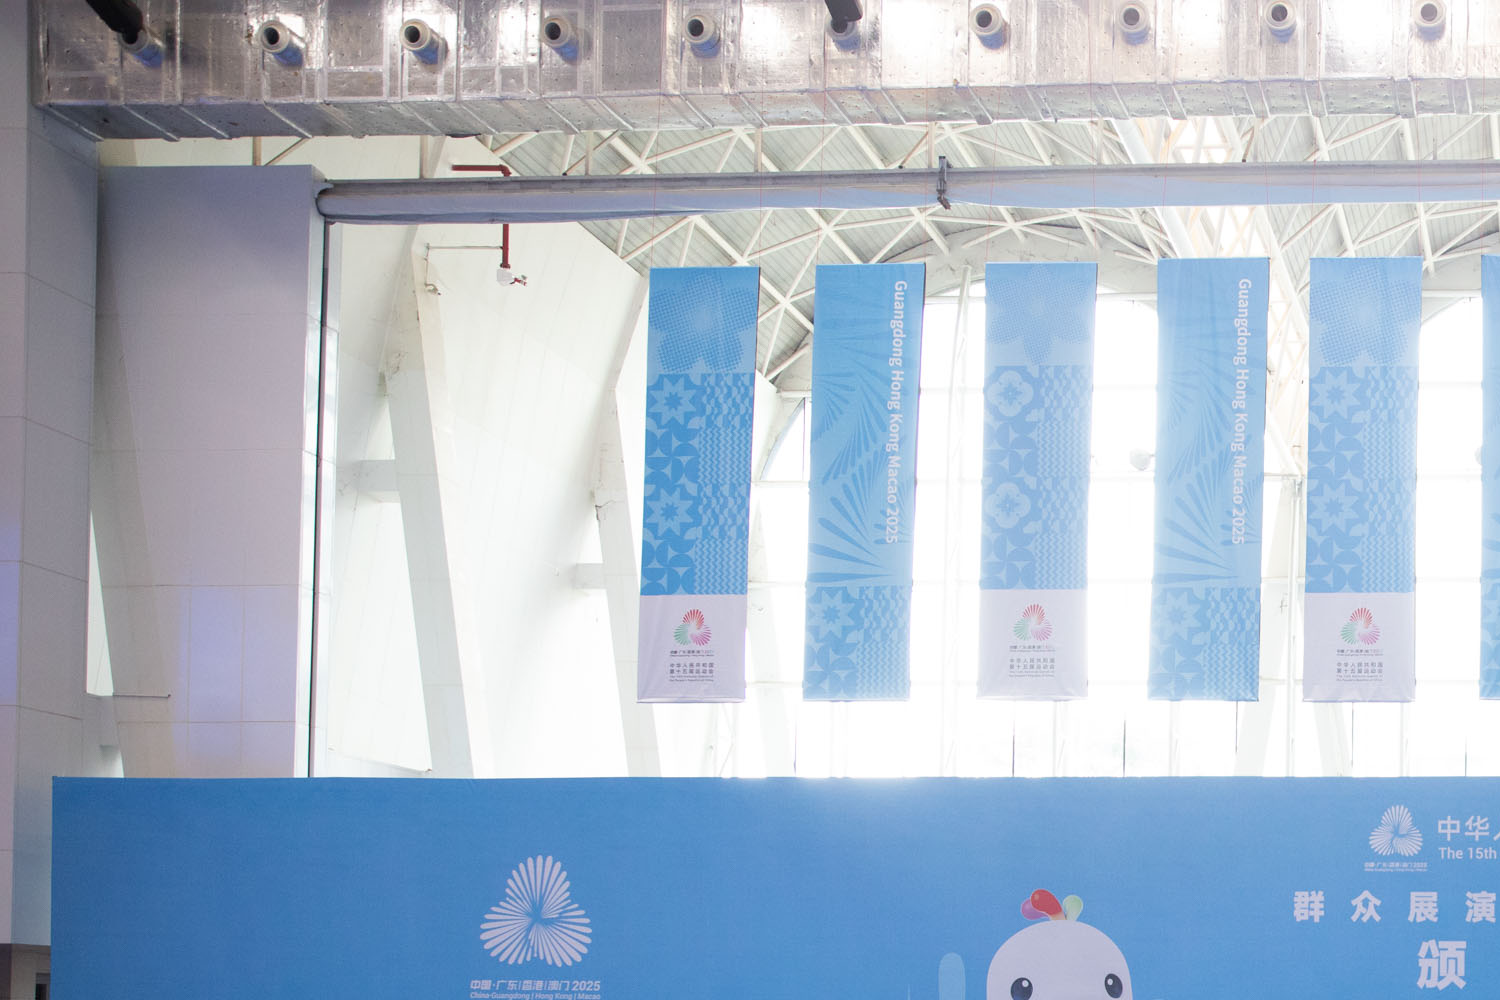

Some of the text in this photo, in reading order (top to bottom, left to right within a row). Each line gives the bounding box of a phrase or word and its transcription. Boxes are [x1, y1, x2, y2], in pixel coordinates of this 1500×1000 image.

[885, 280, 908, 544] Guangdong Hong Kong Macao 2025
[1231, 279, 1252, 544] Guangdong Hong Kong Macao 2025
[1438, 848, 1463, 860] The
[1468, 848, 1497, 860] 15th
[571, 981, 600, 991] 2025
